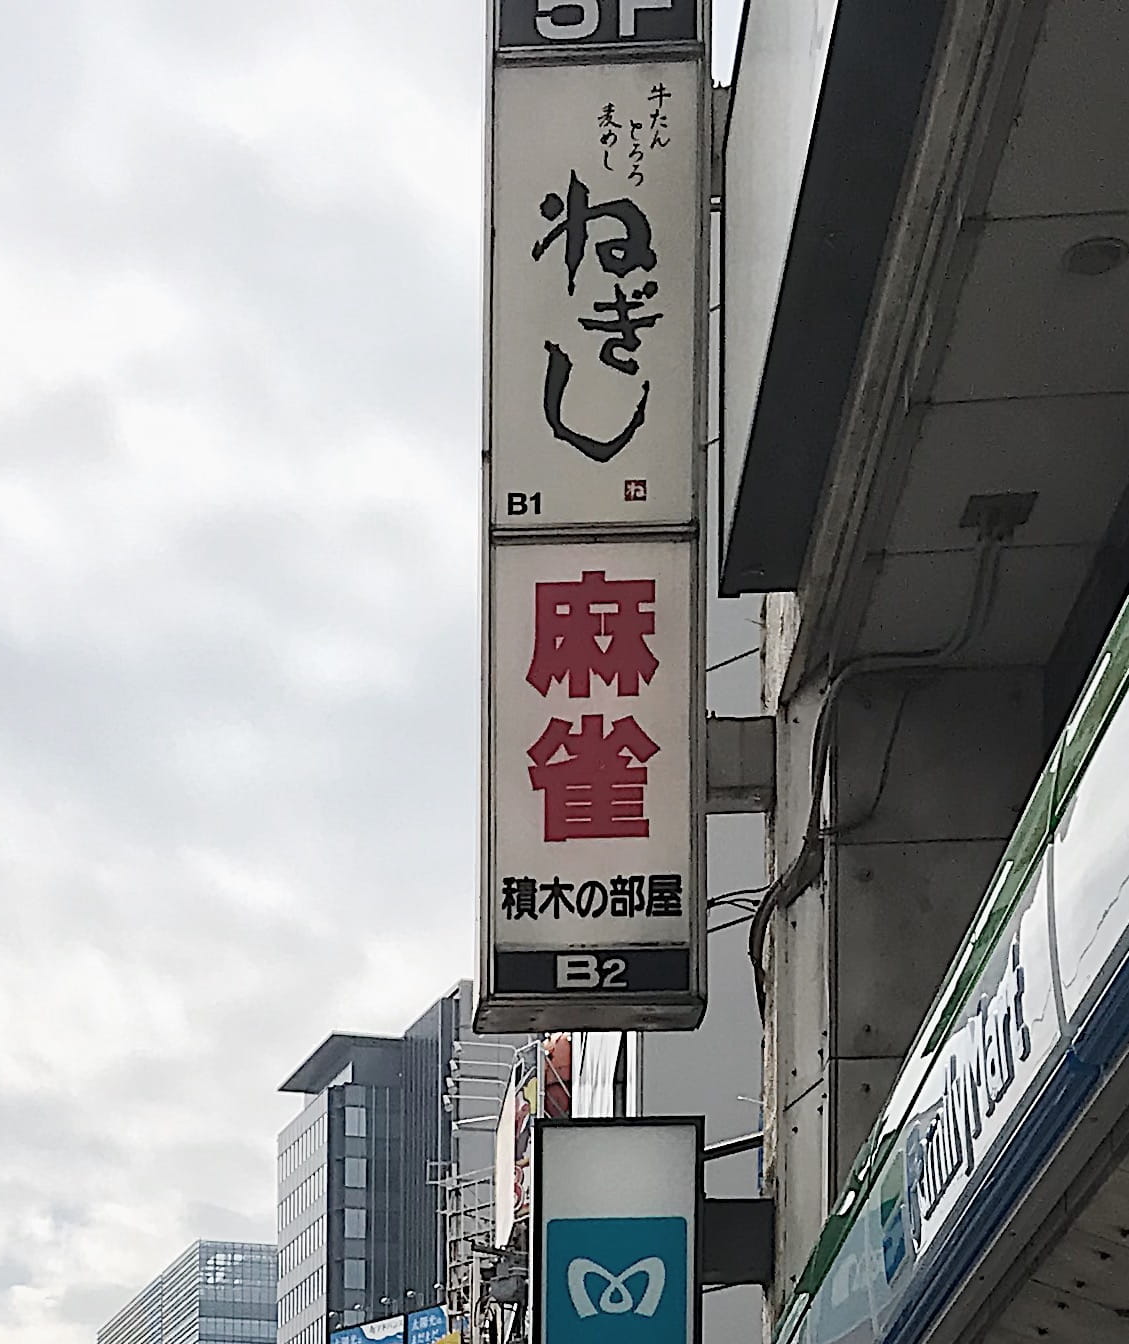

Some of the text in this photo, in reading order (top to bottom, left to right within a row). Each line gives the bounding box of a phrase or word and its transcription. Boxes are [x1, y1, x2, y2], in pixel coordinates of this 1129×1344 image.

[597, 103, 622, 171] 麦めし
[648, 83, 671, 148] 牛たん
[627, 119, 644, 187] とろろ
[532, 170, 664, 463] ねぎし
[507, 492, 542, 516] B1
[526, 570, 661, 843] 麻雀
[501, 874, 683, 920] 積木の部屋
[556, 955, 628, 988] B2
